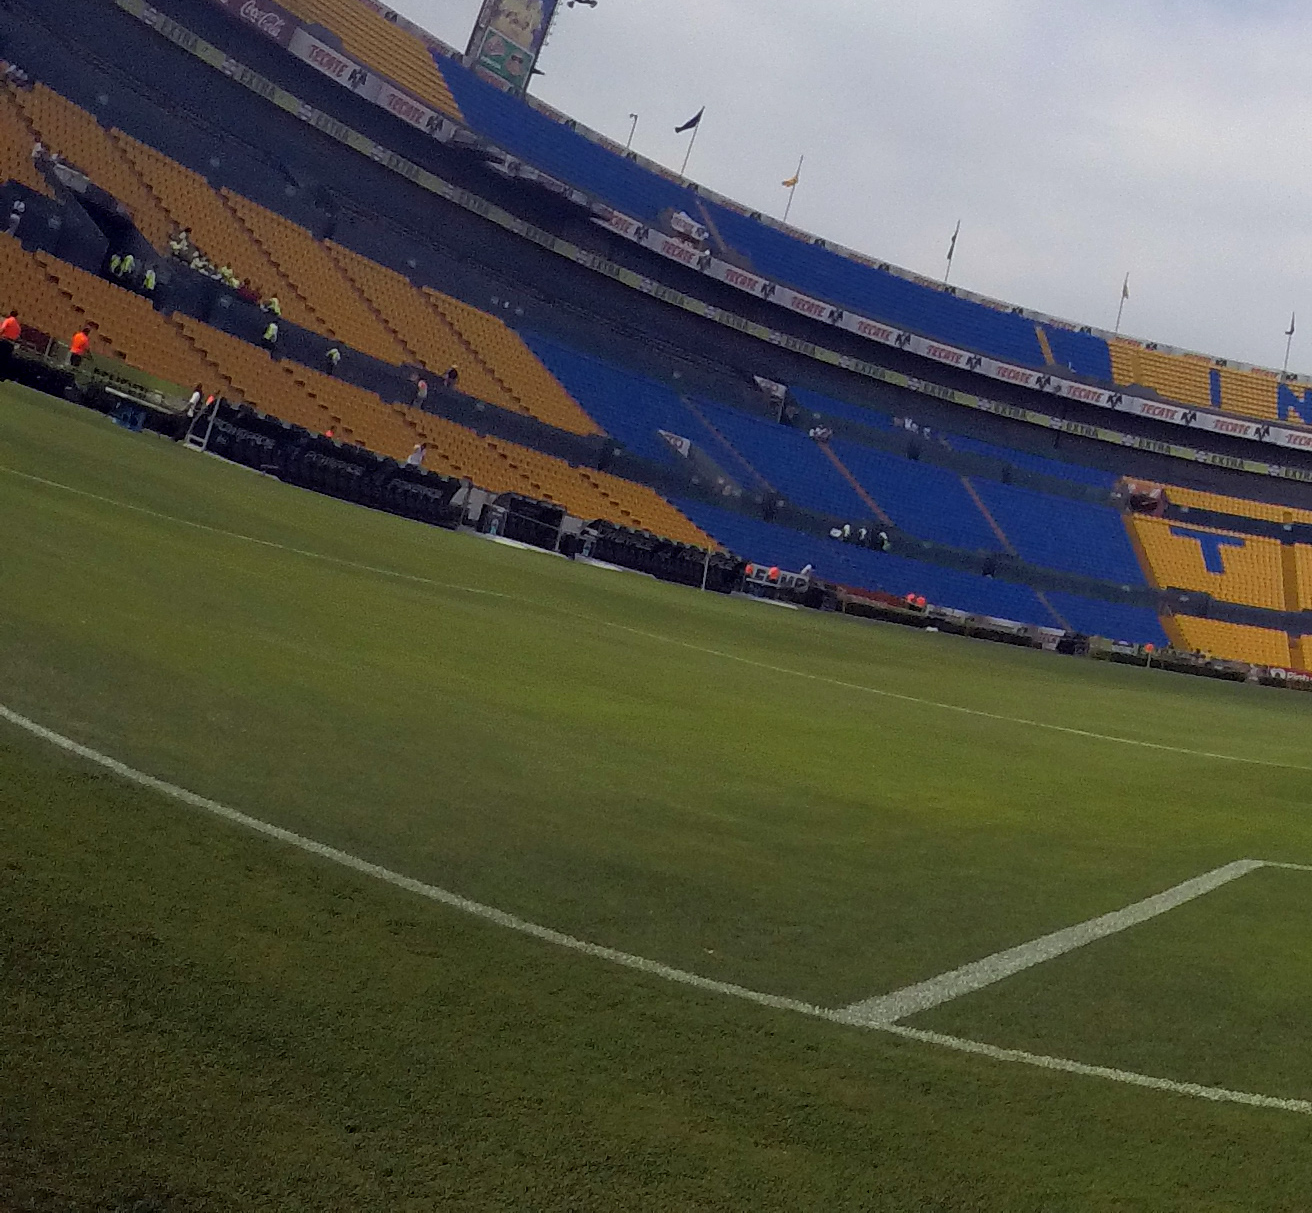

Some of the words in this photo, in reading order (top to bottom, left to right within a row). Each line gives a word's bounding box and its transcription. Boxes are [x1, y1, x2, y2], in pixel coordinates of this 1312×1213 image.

[1067, 385, 1104, 403] TECATE
[1140, 403, 1179, 420] TECATE
[1213, 419, 1250, 435] TECATE
